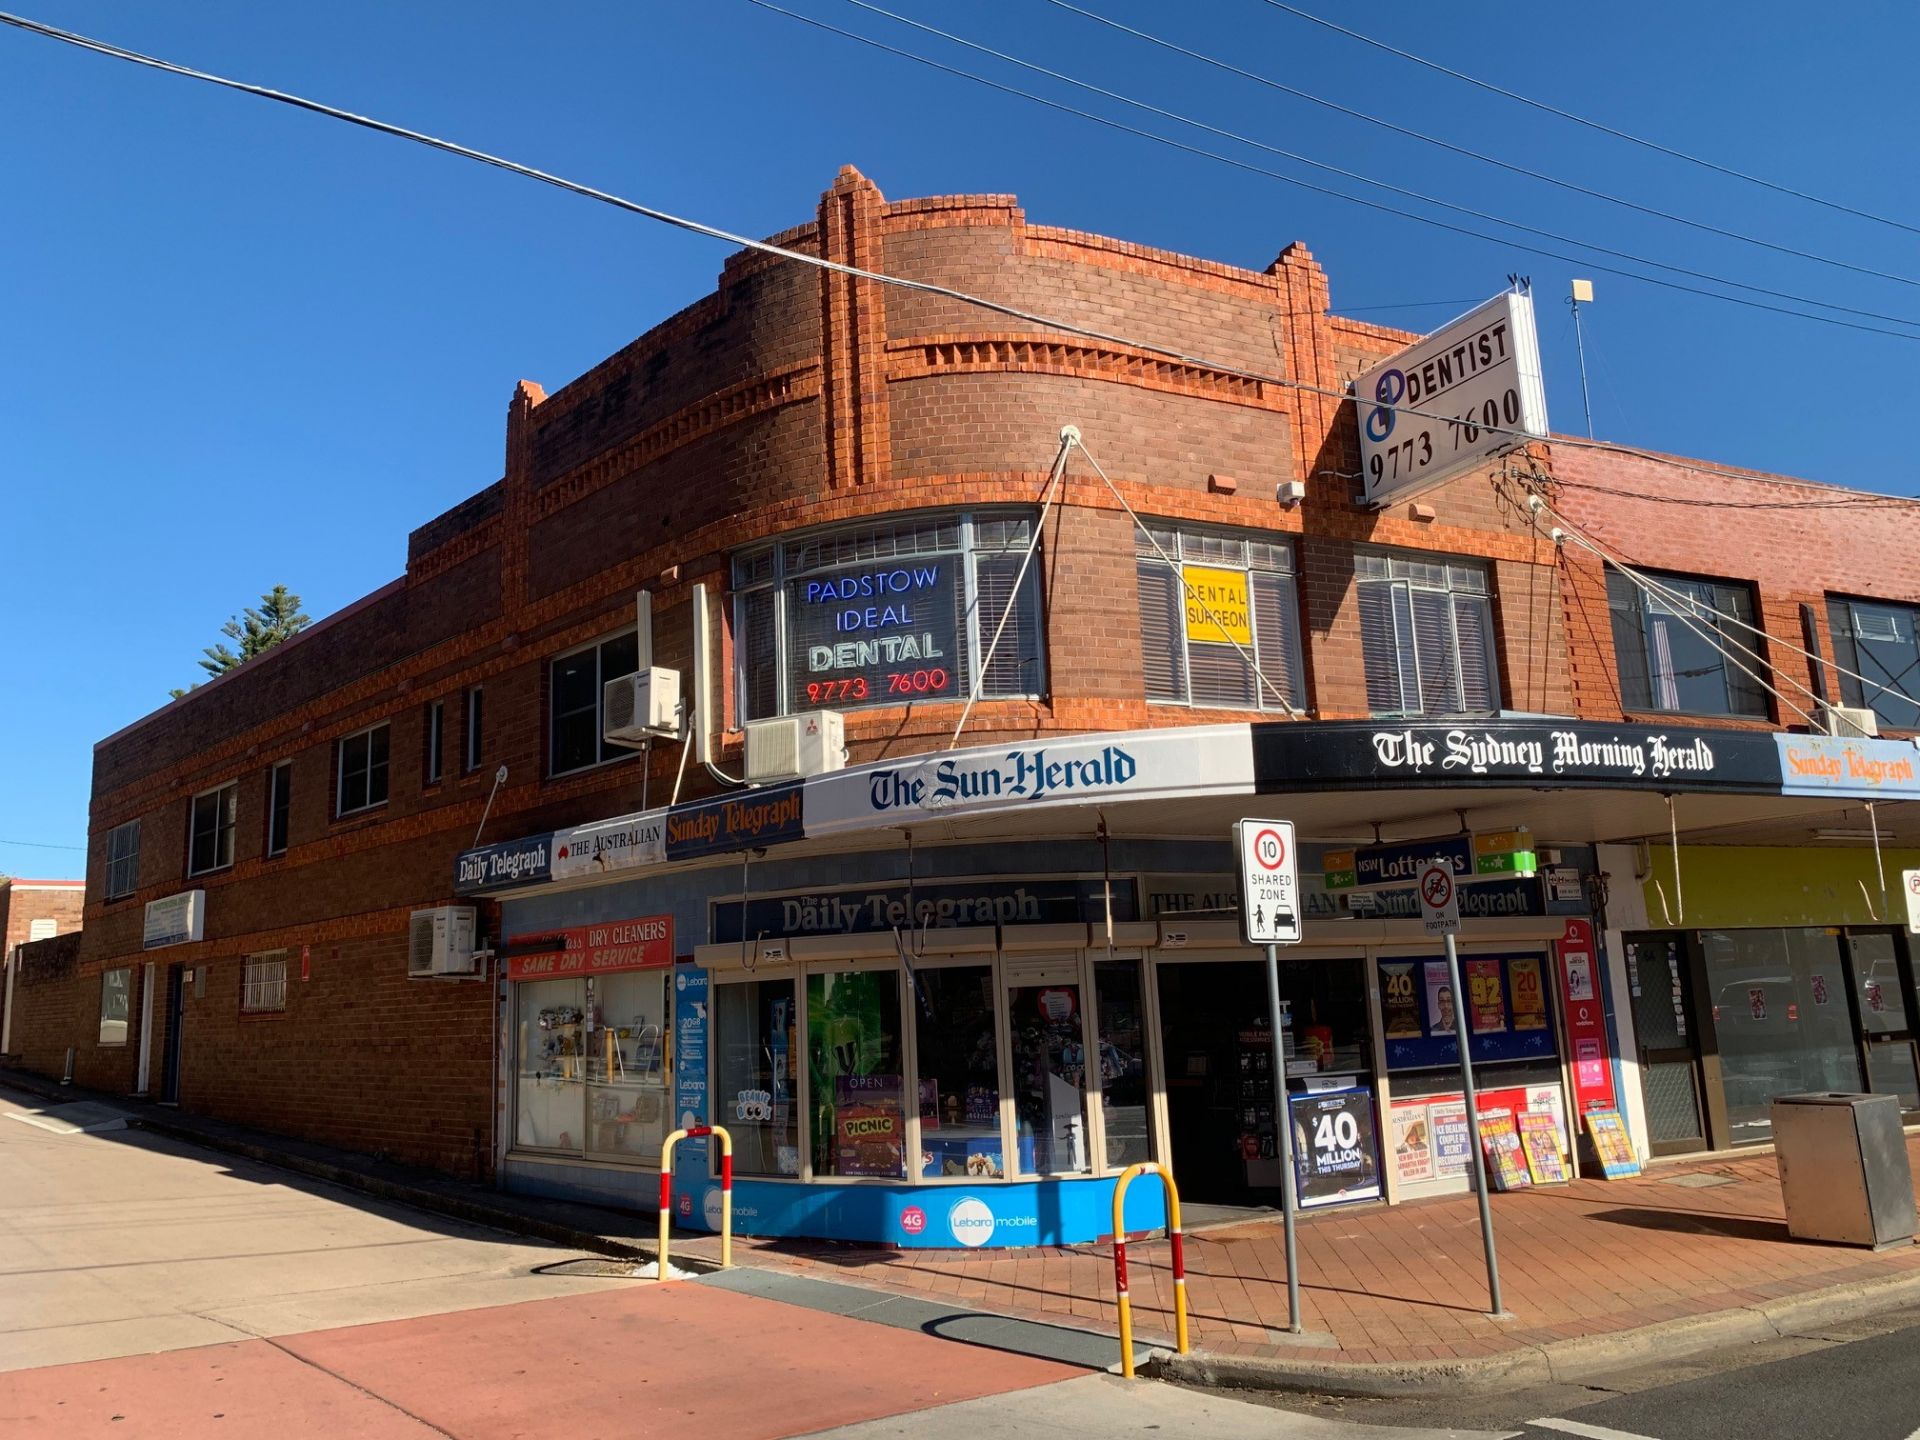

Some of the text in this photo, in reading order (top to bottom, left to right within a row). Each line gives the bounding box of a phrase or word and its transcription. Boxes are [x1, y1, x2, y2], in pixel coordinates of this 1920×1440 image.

[1406, 324, 1506, 404] DENTIST
[1370, 388, 1520, 488] 9773 7600
[807, 566, 940, 603] PADSTOW
[1187, 584, 1246, 605] DENTAL
[837, 604, 913, 631] IDEAL
[1188, 607, 1247, 628] SURGEON
[808, 632, 943, 673] DENTAL
[807, 668, 947, 704] 9773 7600
[1372, 730, 1714, 778] The Sydney Morning Herald
[1787, 748, 1913, 784] Sunday Telegraph
[869, 746, 1136, 810] The Sun-Herald
[668, 790, 801, 845] Sunday Telegraph
[570, 826, 661, 857] THE AUSTRALIAN
[1262, 841, 1277, 859] 10
[459, 843, 545, 884] Daily Telegraph
[1358, 851, 1465, 878] NSW Lottes
[1251, 874, 1292, 886] SHARED
[801, 895, 818, 906] The
[1260, 889, 1286, 901] ZONE
[1375, 887, 1421, 914] Sund
[1457, 884, 1528, 914] elegraph
[782, 889, 1042, 934] Daily Telegraph
[1435, 911, 1446, 919] ON
[589, 929, 610, 948] DRY
[613, 920, 666, 945] CLEANERS
[1426, 920, 1457, 929] FOOTPATH
[522, 945, 646, 974] SAME DAY SERVICE
[1516, 971, 1537, 993] 20
[679, 1079, 705, 1090] Lebara
[849, 1078, 884, 1089] OPEN
[738, 1089, 771, 1104] BEANIE
[846, 1118, 894, 1137] PICNIC
[1316, 1148, 1361, 1166] MILLION
[1318, 1161, 1361, 1175] THIS THURSDAY
[680, 1201, 690, 1211] 4G
[706, 1203, 723, 1214] Leba
[903, 1215, 922, 1227] 4G
[954, 1216, 1037, 1228] Lebara mobile
